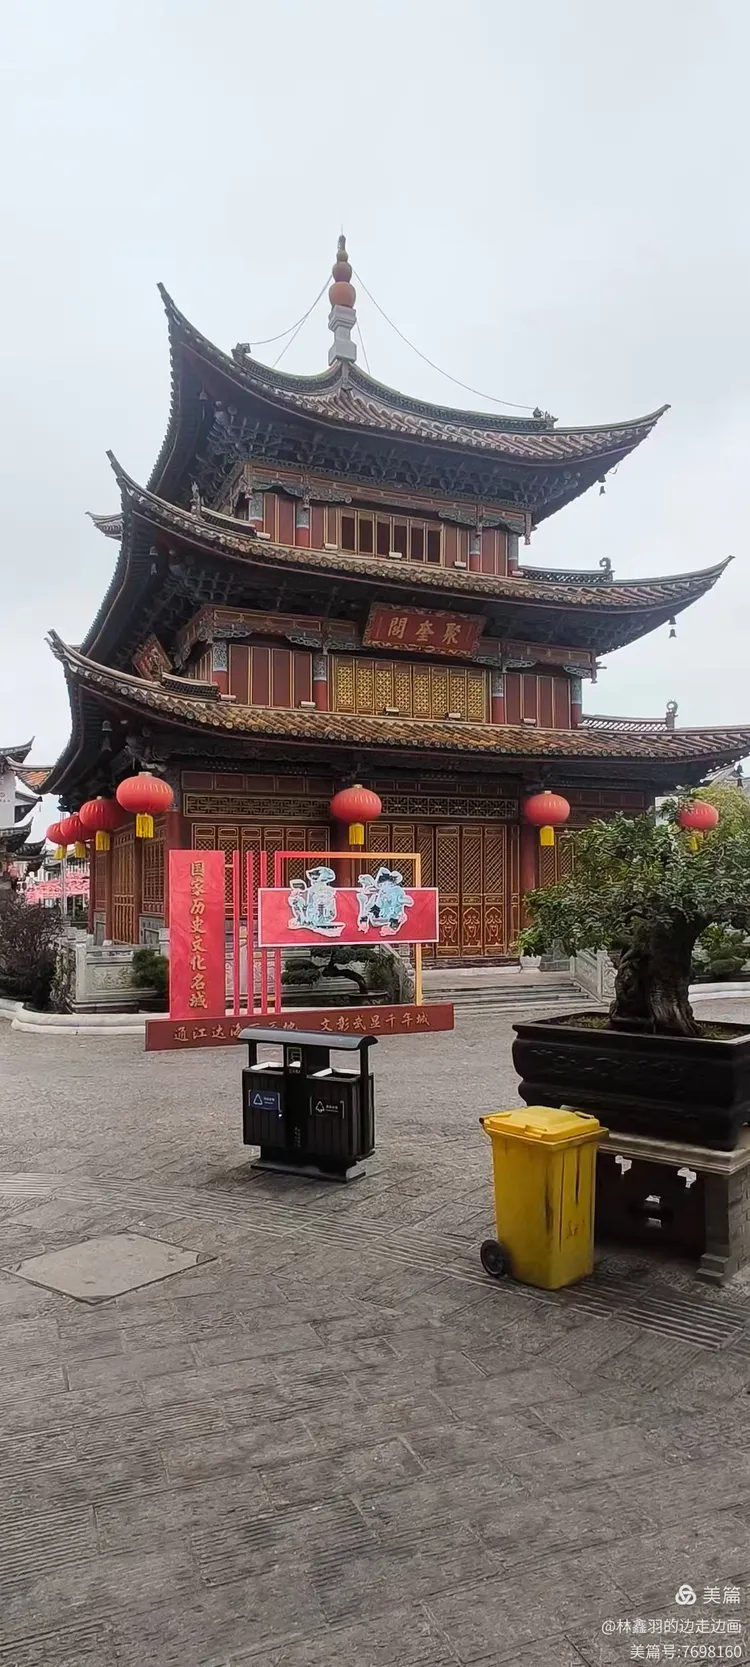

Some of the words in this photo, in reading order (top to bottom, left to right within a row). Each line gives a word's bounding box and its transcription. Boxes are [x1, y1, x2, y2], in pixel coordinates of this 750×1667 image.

[189, 861, 208, 1009] 国家历史文化名城
